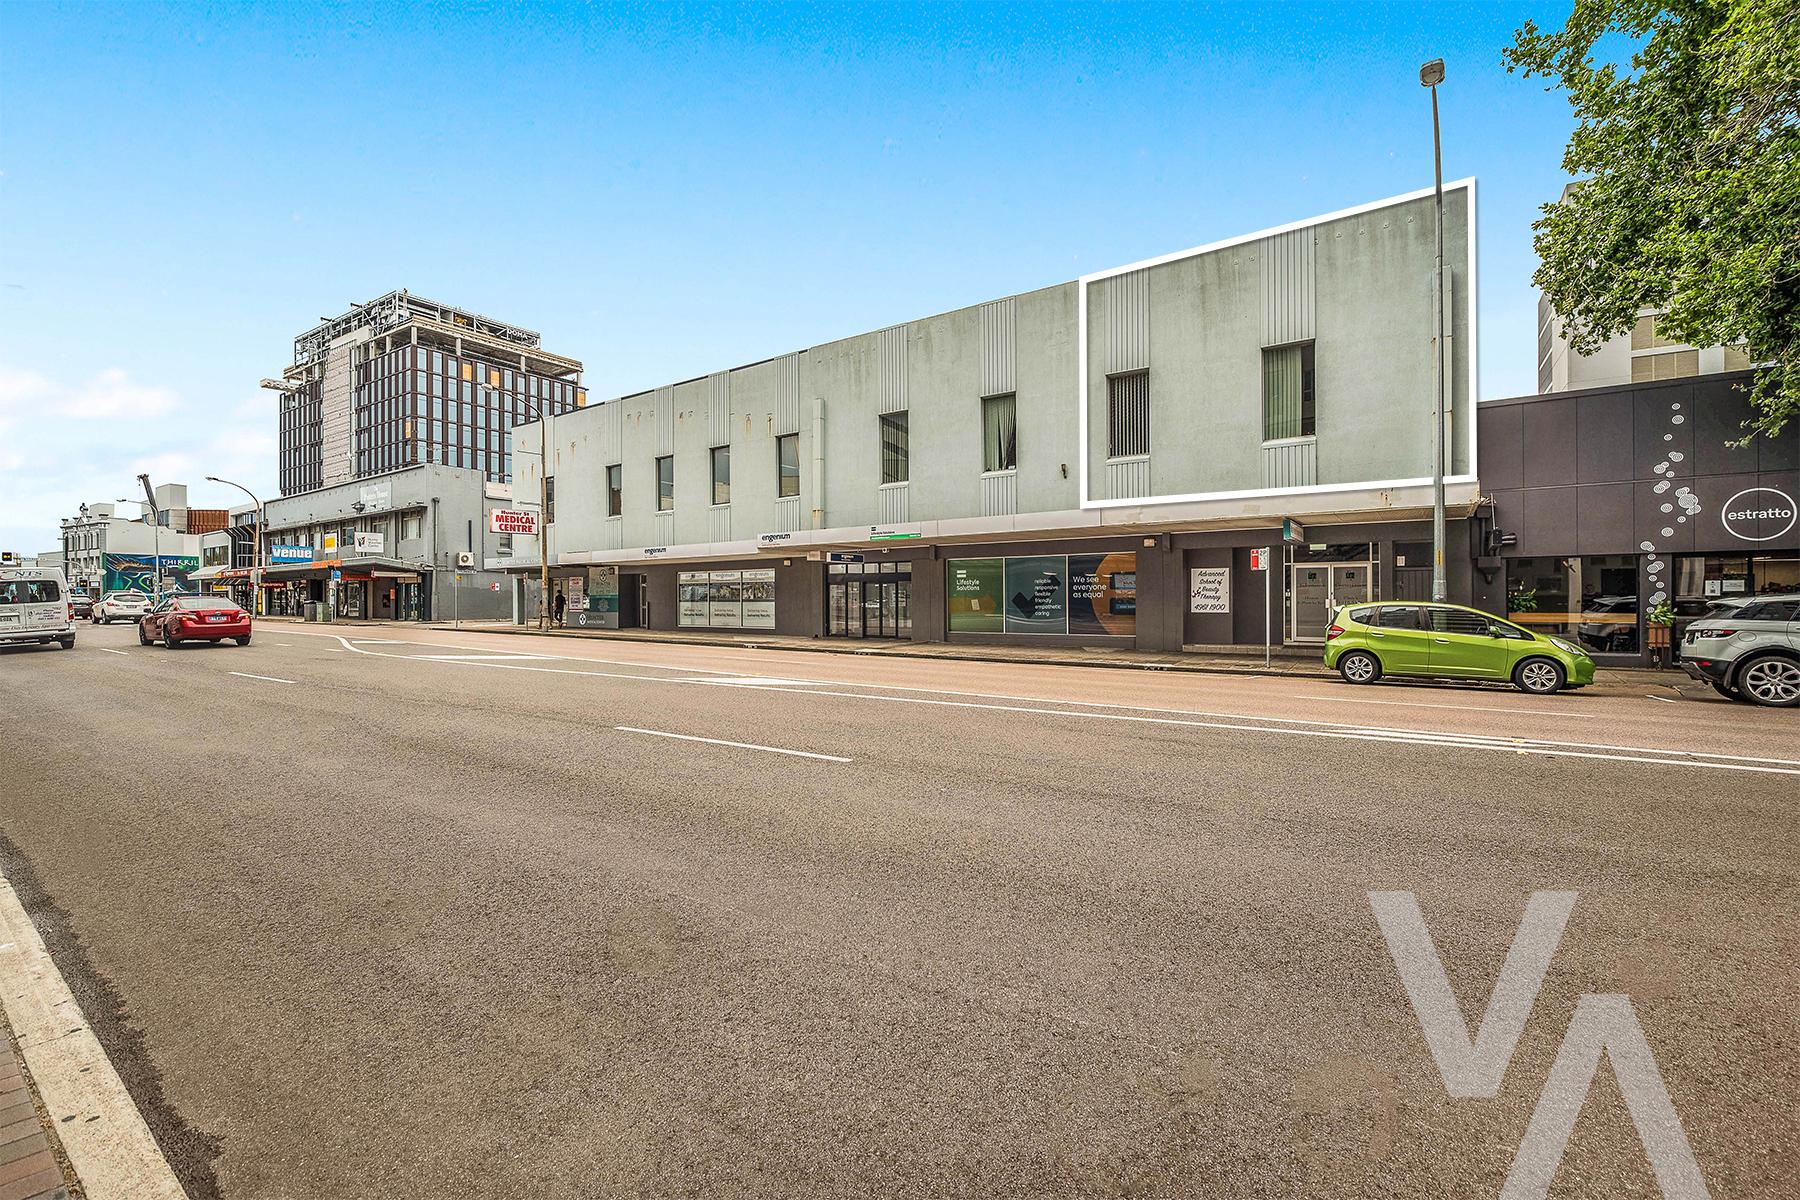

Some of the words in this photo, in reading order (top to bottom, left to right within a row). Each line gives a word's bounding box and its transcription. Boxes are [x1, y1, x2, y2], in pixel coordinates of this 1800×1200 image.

[1728, 508, 1792, 520] estratto
[495, 514, 536, 525] MEDICAL
[498, 523, 533, 533] CENTRE
[761, 533, 791, 542] engenium
[272, 547, 312, 558] venue
[644, 547, 667, 555] engenium
[956, 579, 980, 587] Lifestyle
[1216, 578, 1223, 586] of
[1201, 586, 1219, 594] Beauty
[1082, 591, 1104, 599] equal
